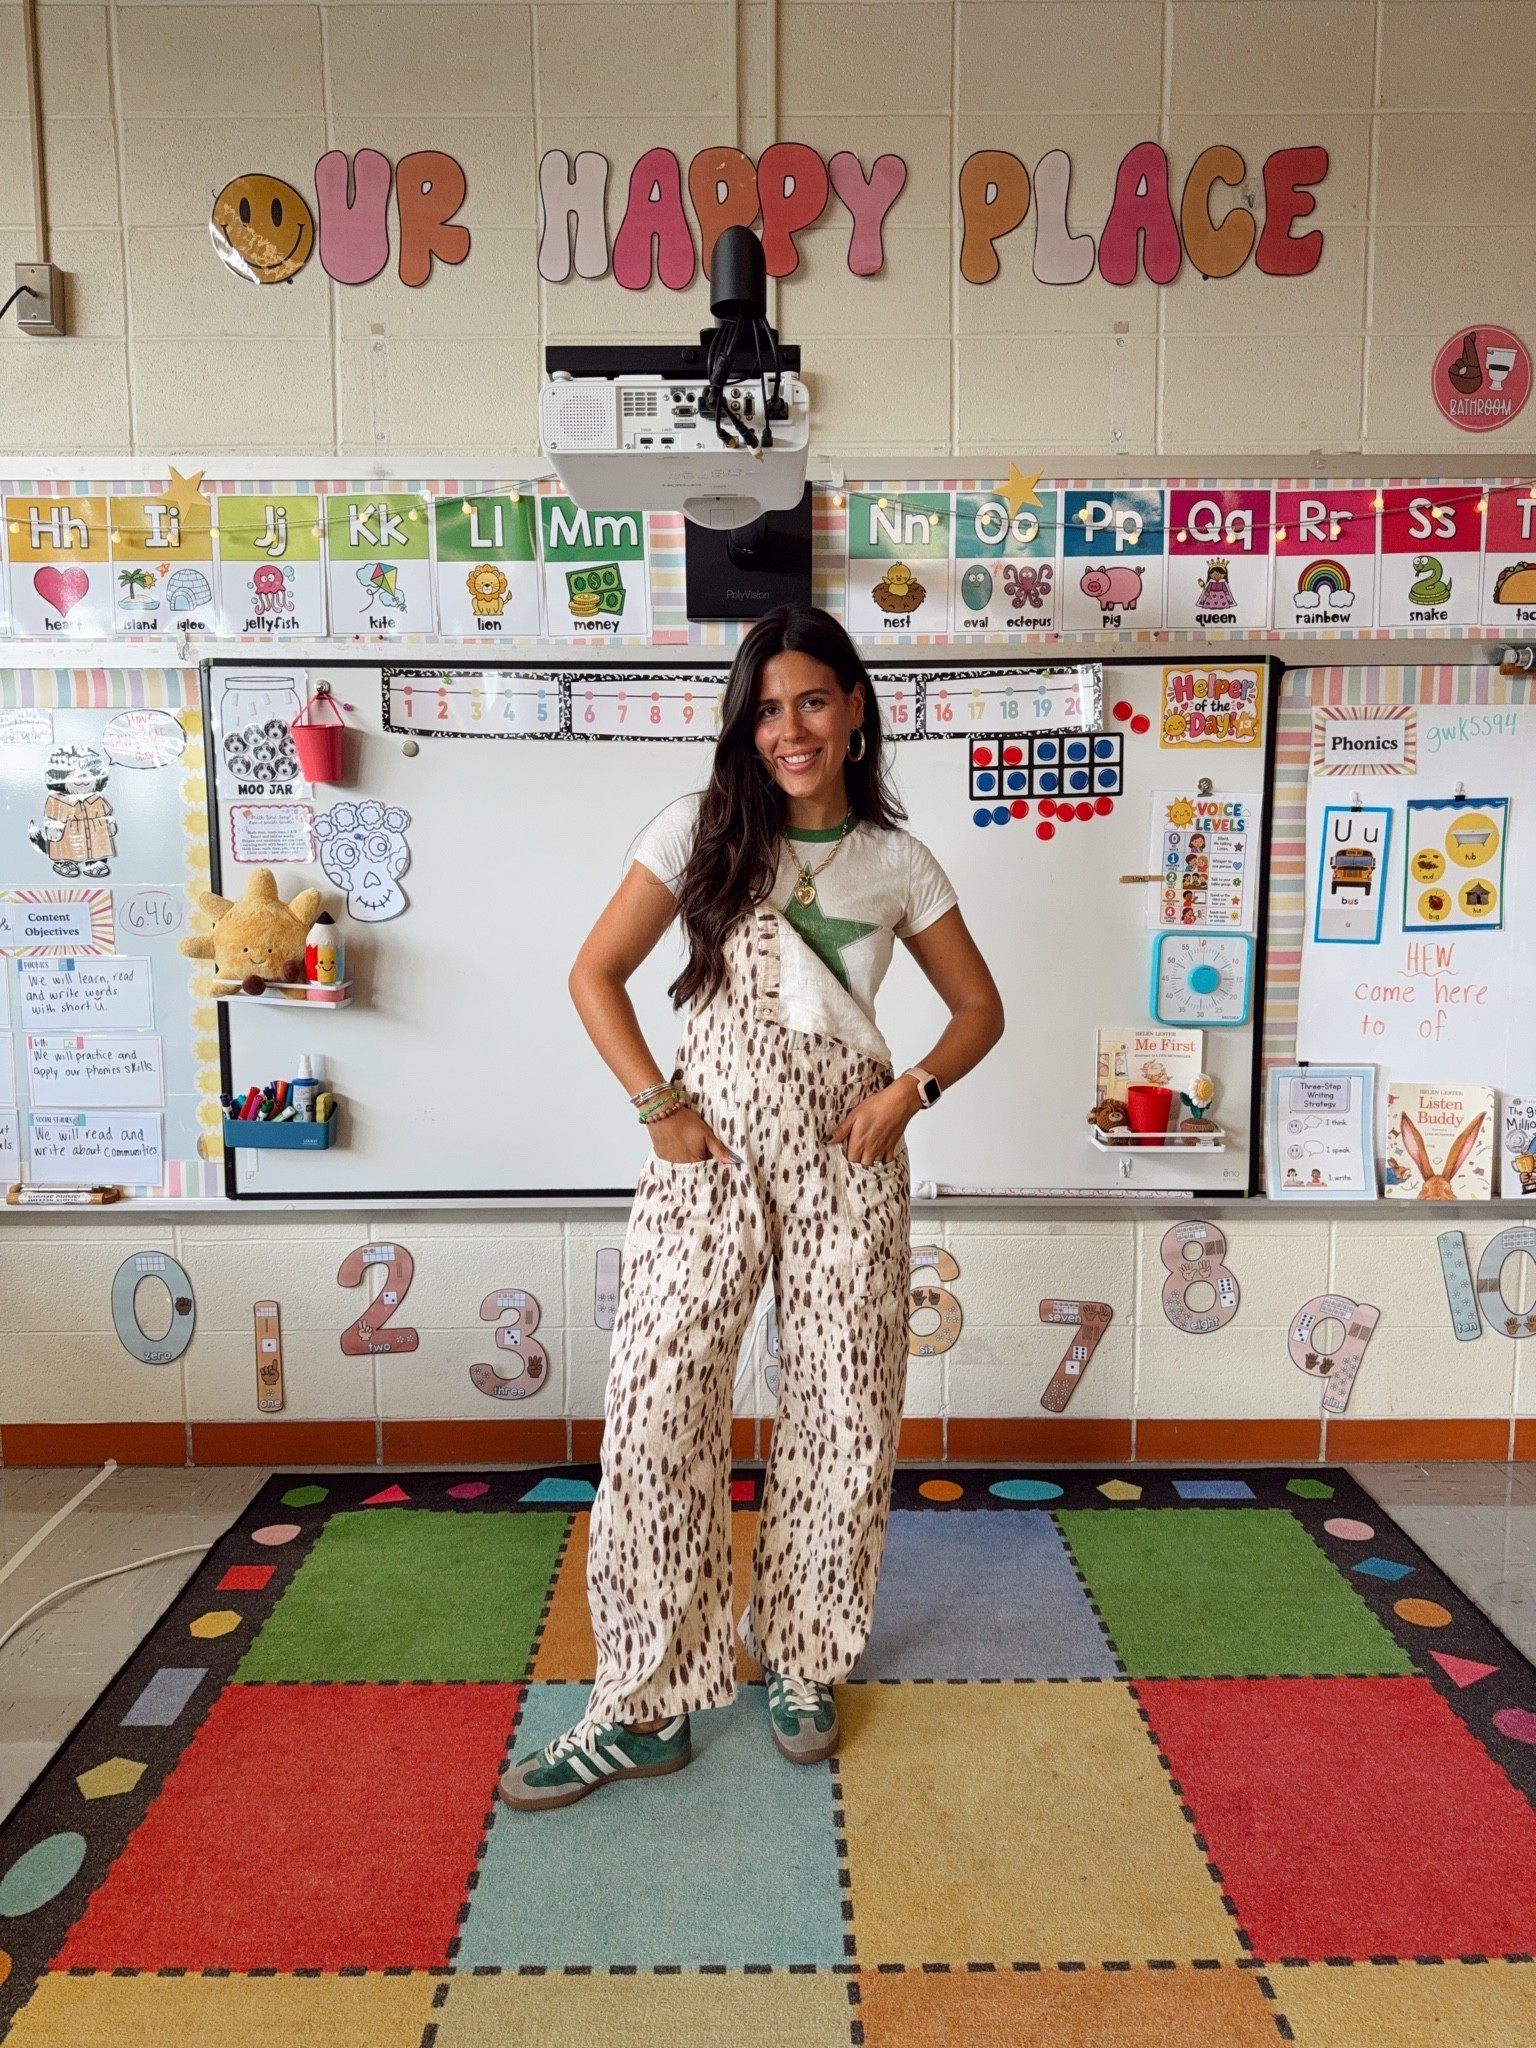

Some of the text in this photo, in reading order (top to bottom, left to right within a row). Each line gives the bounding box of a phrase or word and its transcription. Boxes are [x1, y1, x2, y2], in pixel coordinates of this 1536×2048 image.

[538, 142, 907, 291] HAPPY
[960, 142, 1329, 285] PLACE
[1449, 398, 1512, 416] BATHROOM
[144, 505, 181, 548] Ii
[348, 504, 408, 546] Kk
[868, 502, 931, 545] Nn
[974, 501, 1039, 545] Oo
[1084, 500, 1144, 552] Pp
[1188, 500, 1253, 550] Qq
[1299, 500, 1353, 542] Rr
[1408, 498, 1456, 540] Ss
[29, 506, 88, 549] Hh
[253, 505, 288, 557] Jj
[550, 506, 638, 549] Mm
[726, 590, 770, 600] PolyVision
[884, 615, 912, 629] nest
[1102, 614, 1122, 628] pig
[1195, 612, 1237, 627] queen
[1295, 611, 1351, 624] rainbow
[1408, 608, 1448, 622] snake
[45, 617, 82, 631] heat
[124, 618, 206, 632] island igloo
[242, 616, 300, 632] jellyfish
[370, 616, 396, 630] kite
[477, 617, 502, 631] lion
[574, 619, 620, 633] money
[964, 616, 1052, 631] oval octopus
[1172, 673, 1254, 703] Helper
[404, 700, 548, 721] 1 2 3 4 5
[934, 703, 953, 722] 16
[968, 702, 986, 720] 17
[1000, 701, 1019, 719] 18
[1033, 699, 1052, 717] 19
[1195, 700, 1230, 712] of the
[584, 705, 694, 725] 6 7 8 9
[890, 705, 908, 724] 15
[1189, 712, 1237, 738] Day!
[1330, 736, 1398, 750] Phonics
[238, 784, 293, 796] MOO JAR
[1197, 802, 1242, 816] VOICE
[1196, 818, 1245, 832] LEVELS
[1335, 818, 1378, 842] U u
[1342, 897, 1358, 905] bus
[28, 913, 70, 922] Content
[25, 927, 80, 936] Objectives
[1406, 942, 1456, 972] HFW
[28, 970, 134, 987] We will learn, read
[26, 986, 118, 1001] and write words
[1354, 978, 1488, 1004] come here
[32, 1004, 56, 1015] with
[61, 1001, 90, 1012] short
[1361, 1009, 1447, 1041] to of
[1135, 1038, 1196, 1052] Me First
[34, 1049, 138, 1063] We will practice and
[34, 1067, 58, 1080] apply
[86, 1063, 121, 1078] phonics
[1300, 1082, 1341, 1090] Three-Step
[1307, 1092, 1334, 1100] Writing
[1419, 1096, 1463, 1110] Listen
[1304, 1100, 1336, 1108] Strategy
[1508, 1106, 1522, 1116] The
[1418, 1111, 1464, 1128] Buddy
[34, 1127, 144, 1142] We will read and
[34, 1145, 65, 1156] write
[73, 1144, 101, 1156] about
[1160, 1220, 1240, 1334] 8
[1436, 1225, 1536, 1342] 10
[337, 1242, 419, 1356] 2
[908, 1245, 963, 1356] 6
[111, 1250, 196, 1365] 0
[1048, 1312, 1082, 1323] seven
[1190, 1316, 1220, 1331] eight
[1457, 1321, 1478, 1333] ten
[368, 1342, 391, 1352] two
[469, 1288, 548, 1400] 3
[919, 1344, 935, 1355] six
[144, 1350, 172, 1361] zero
[254, 1300, 284, 1412] 1
[1039, 1298, 1113, 1412] 7
[1288, 1294, 1381, 1414] 9
[493, 1385, 525, 1396] three
[259, 1398, 281, 1408] one
[1322, 1396, 1346, 1411] nine
